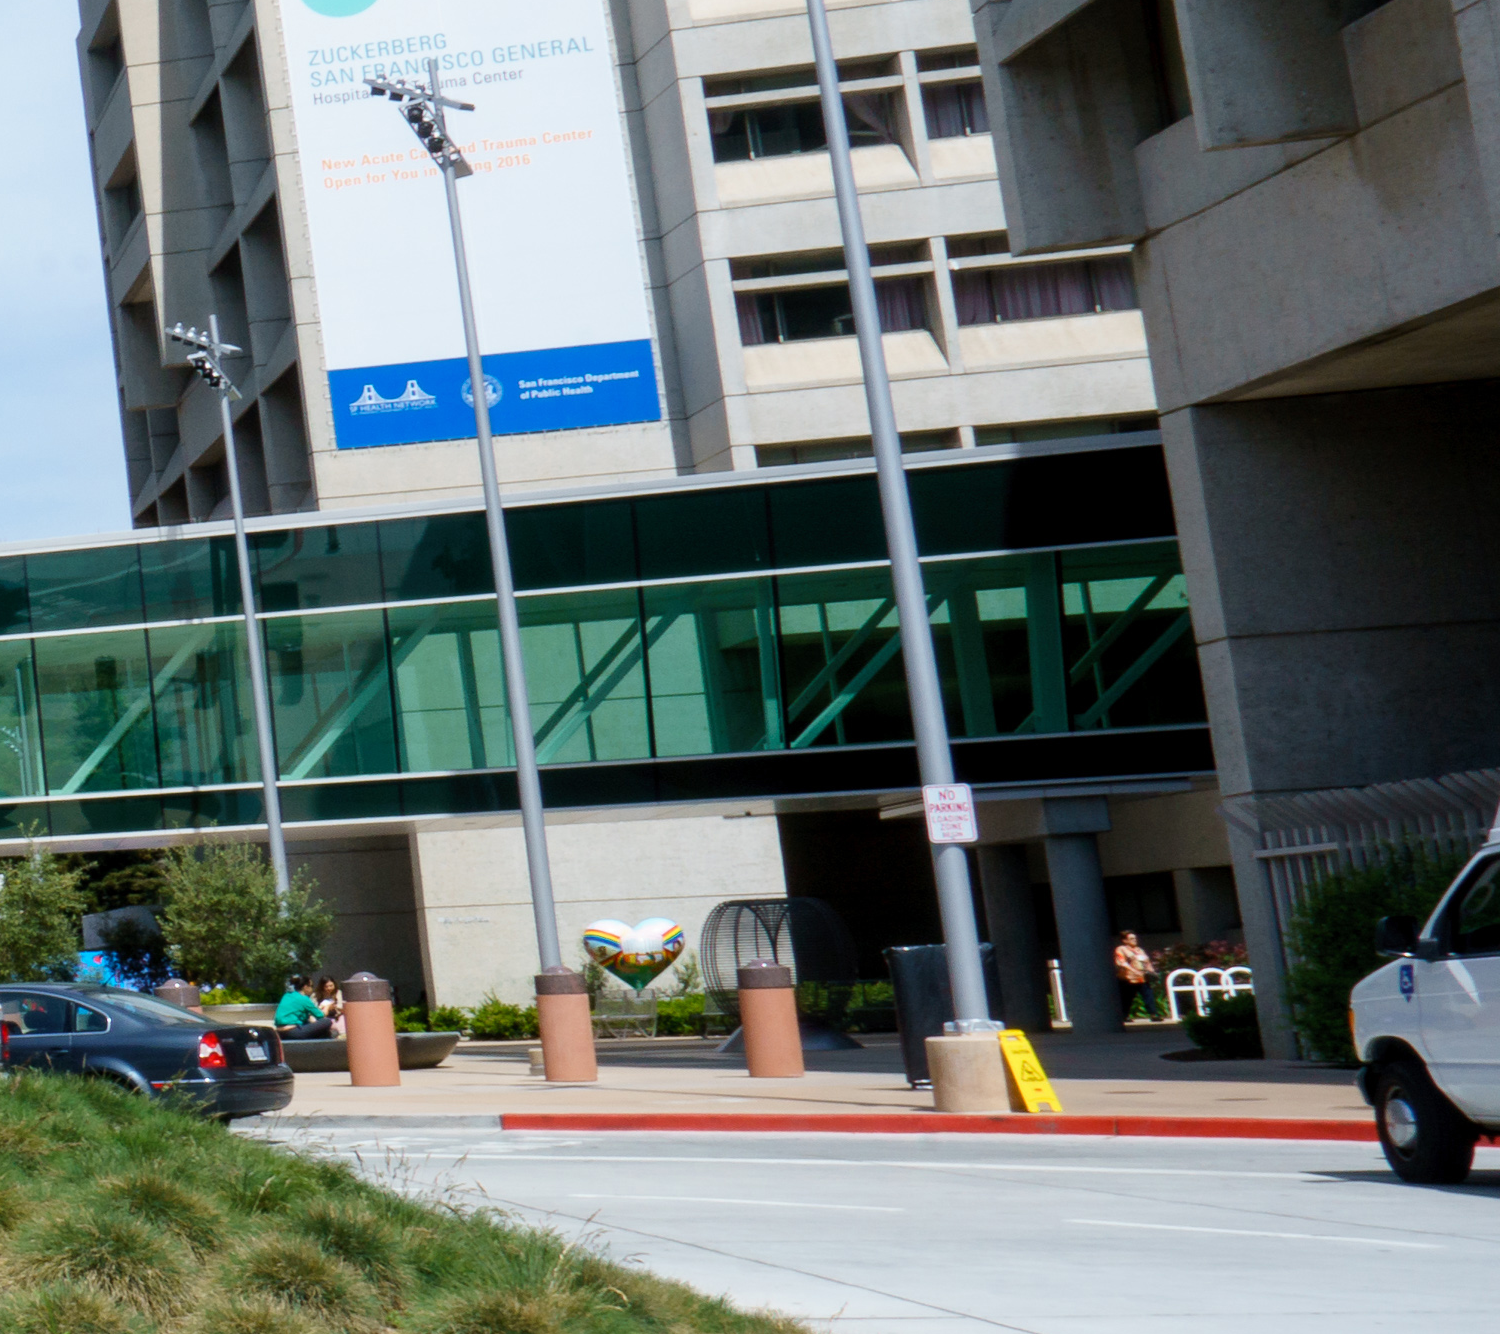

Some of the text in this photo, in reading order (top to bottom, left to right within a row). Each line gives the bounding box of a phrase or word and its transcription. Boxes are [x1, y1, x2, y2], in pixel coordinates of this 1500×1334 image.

[308, 33, 447, 67] ZUCKERBERG
[310, 67, 354, 87] SAN
[492, 36, 594, 65] GENERAL
[313, 88, 370, 105] Hospita
[473, 69, 524, 85] Center
[321, 159, 356, 171] New
[361, 153, 404, 167] Acute
[481, 136, 537, 151] Trauma
[543, 129, 593, 144] Center
[324, 176, 361, 191] Open
[366, 171, 386, 184] for
[391, 168, 419, 181] You
[424, 165, 438, 177] in
[497, 153, 531, 168] 2016
[519, 370, 640, 389] San Francisco Department
[531, 388, 561, 399] Public
[562, 385, 594, 396] Health
[929, 802, 969, 813] PARKING
[939, 790, 955, 801] NO
